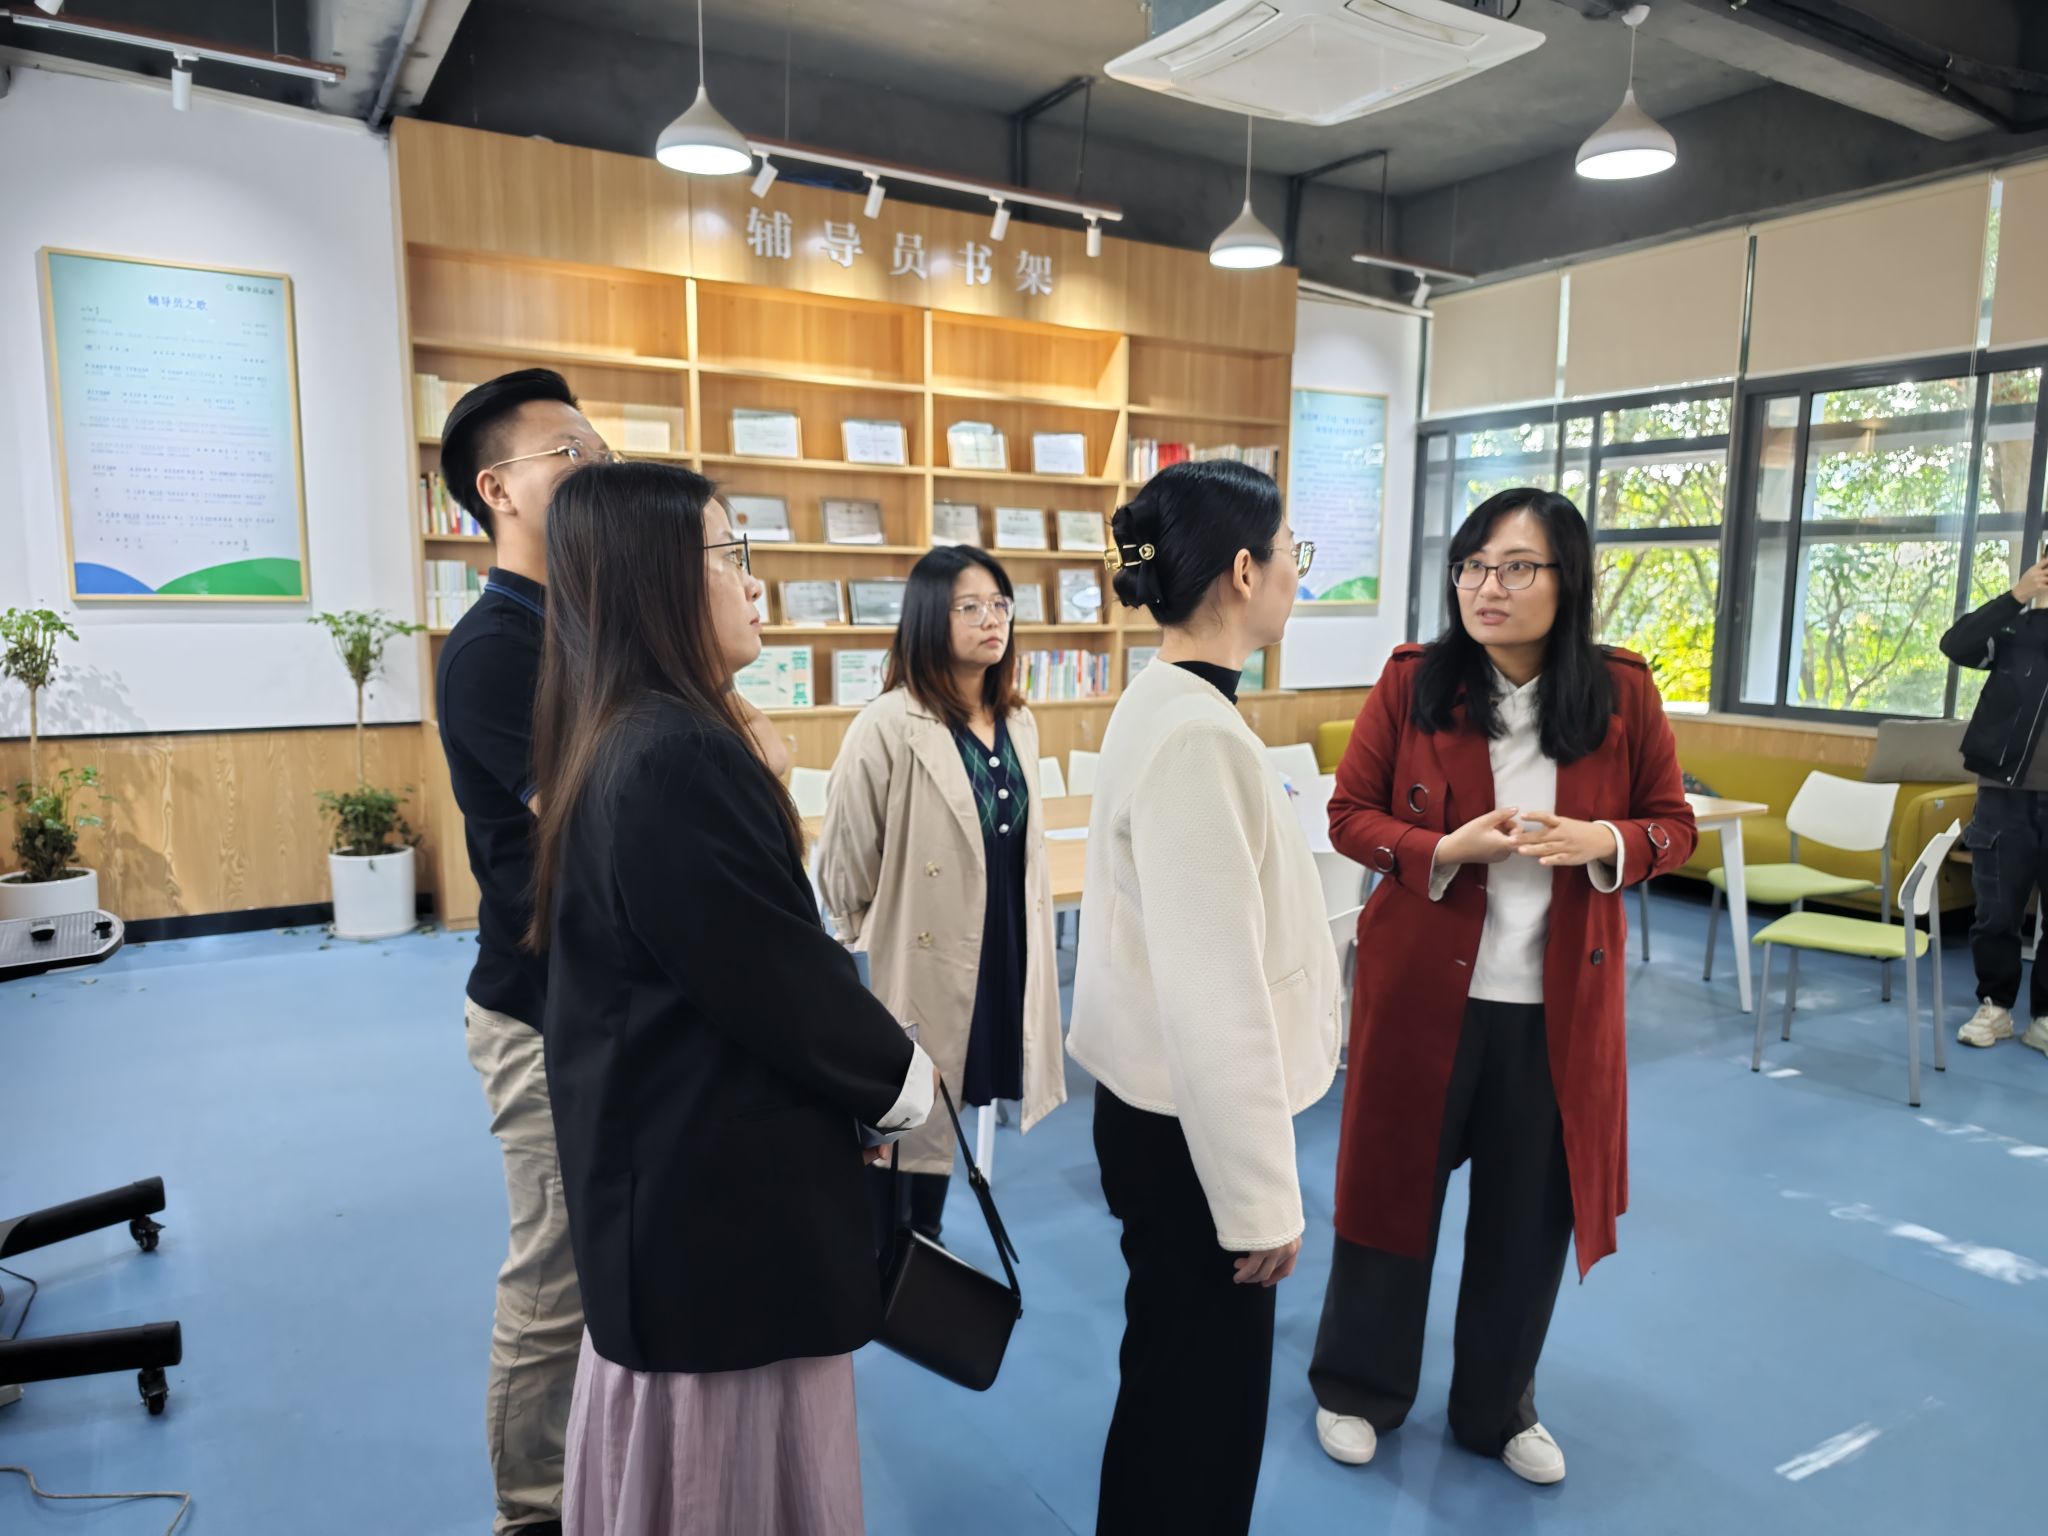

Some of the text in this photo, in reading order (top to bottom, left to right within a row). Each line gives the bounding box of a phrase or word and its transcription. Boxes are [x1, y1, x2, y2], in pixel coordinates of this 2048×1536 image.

[747, 207, 1053, 296] 辅导员书架
[147, 294, 208, 311] 辅导员之歌
